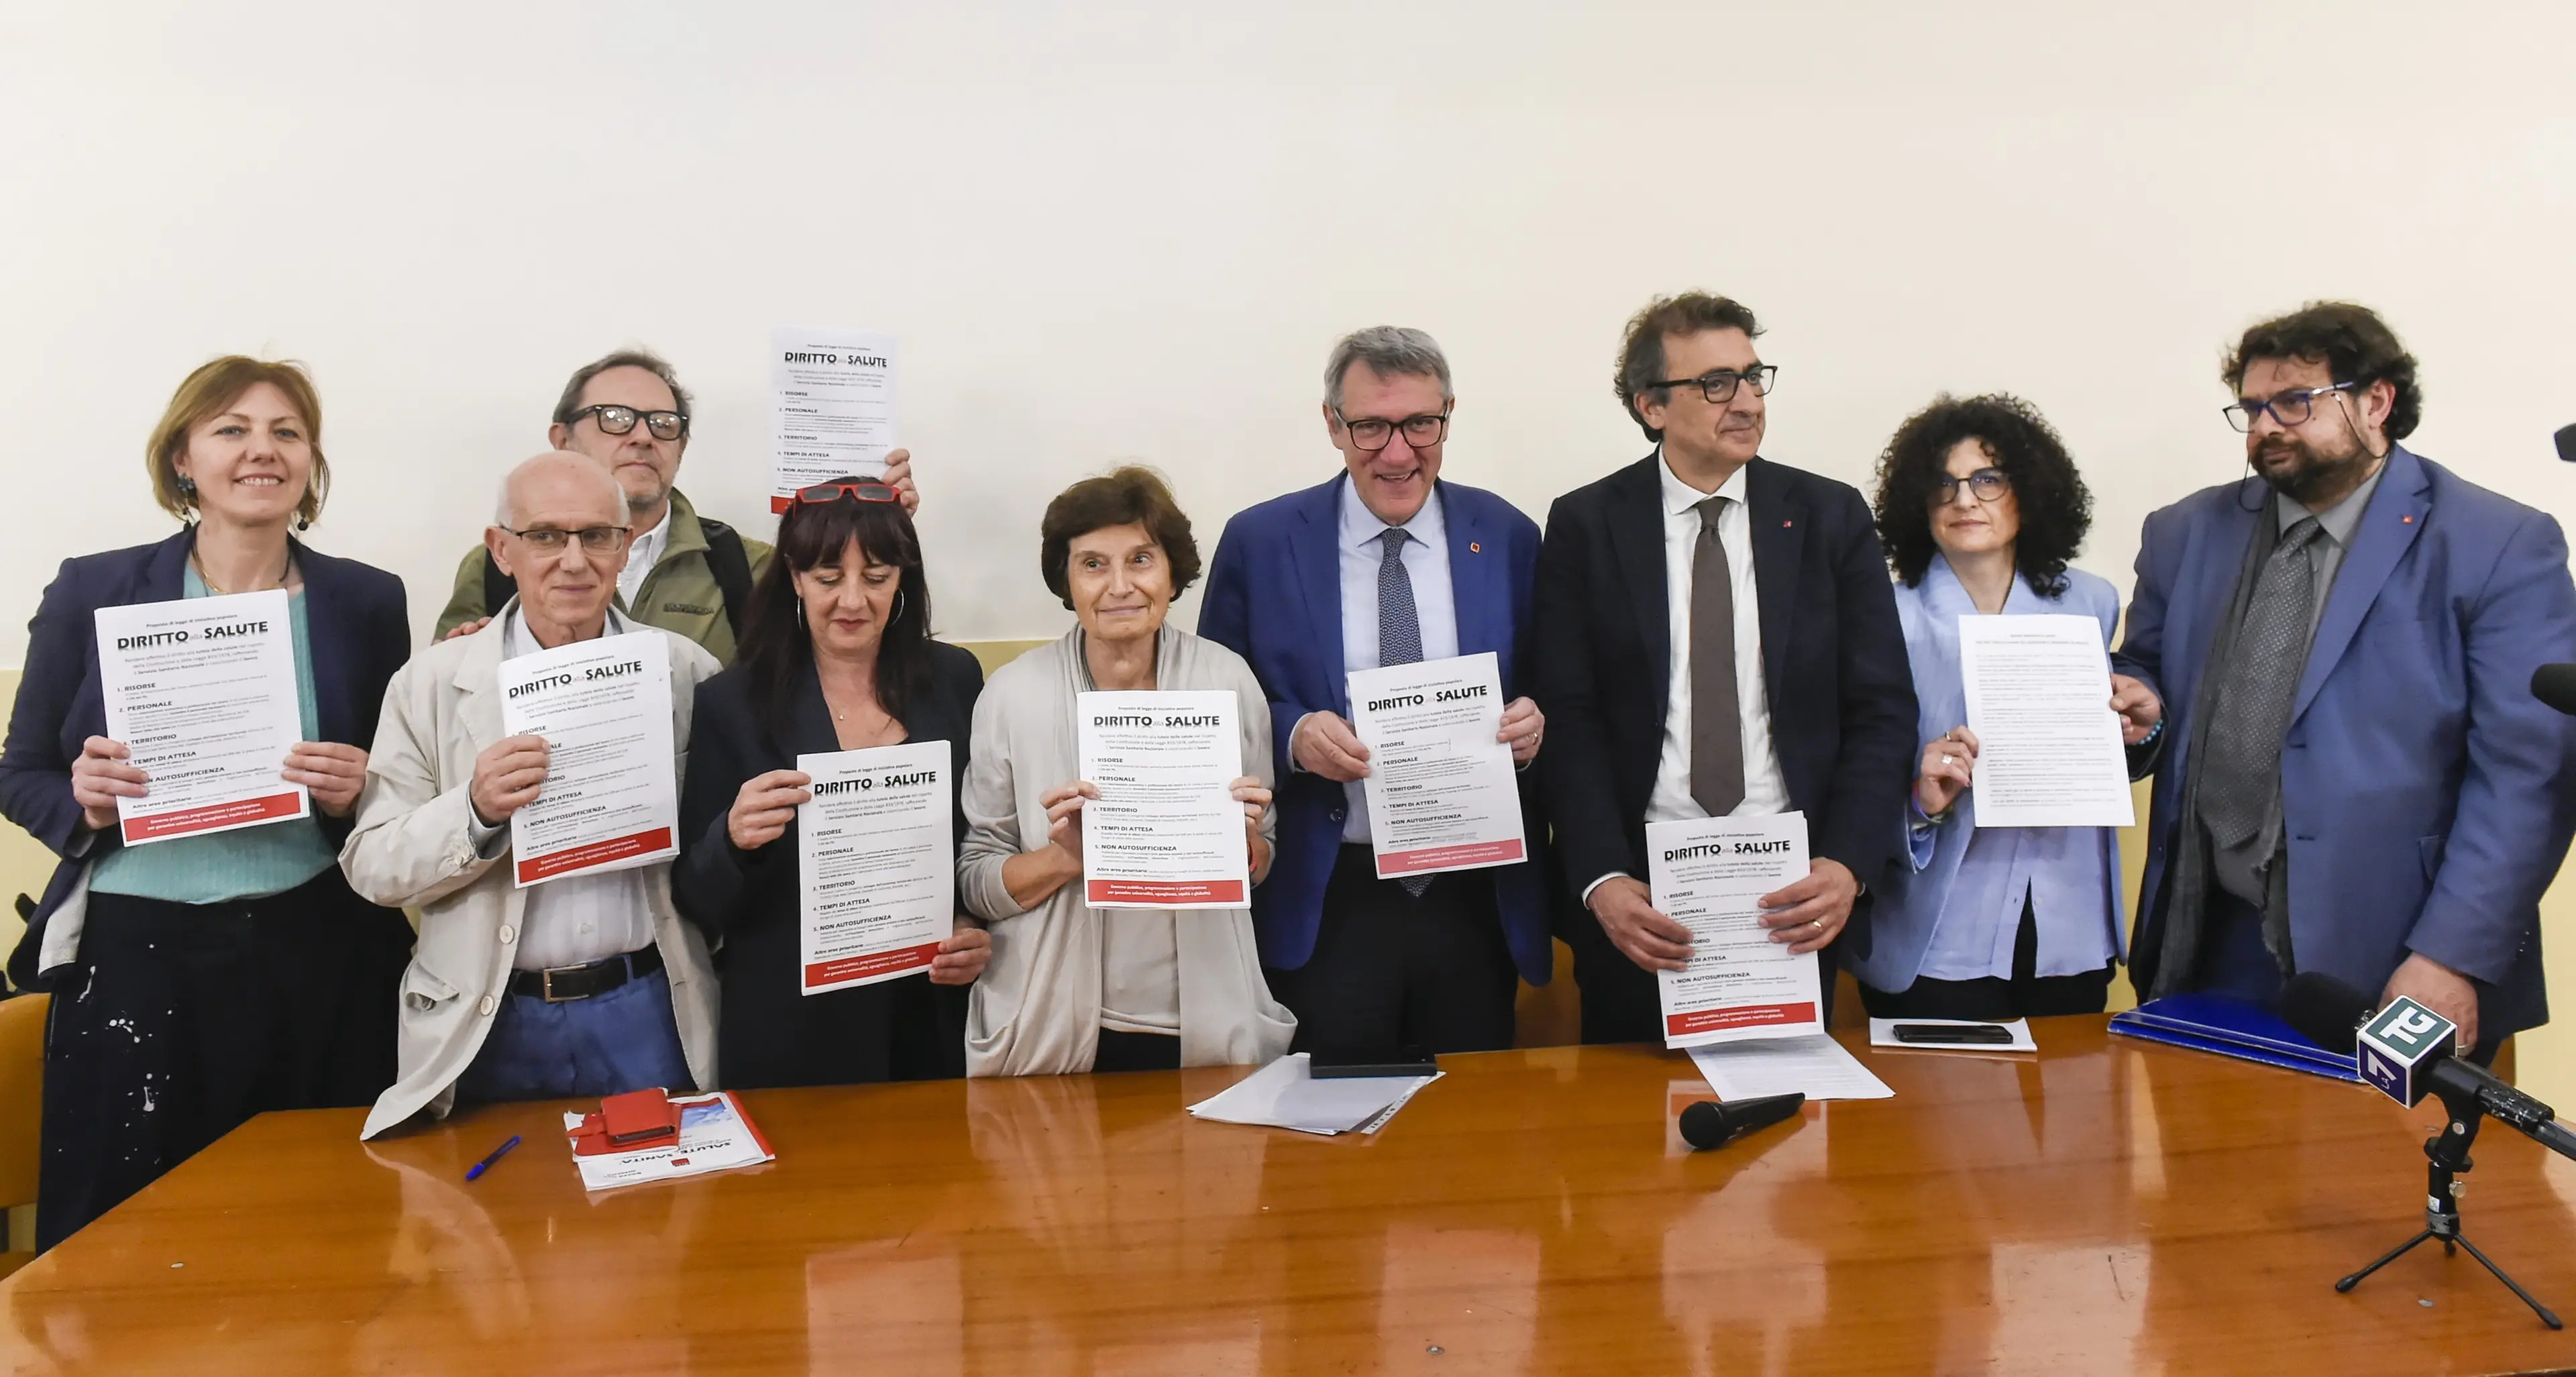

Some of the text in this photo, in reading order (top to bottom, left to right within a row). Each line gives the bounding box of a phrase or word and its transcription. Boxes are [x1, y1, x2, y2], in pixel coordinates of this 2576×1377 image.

[785, 352, 837, 364] DIRITTO
[848, 355, 887, 368] SALUTE
[117, 630, 189, 649] DIRITTO
[205, 621, 268, 639] SALUTE
[508, 673, 572, 698] DIRITTO
[586, 661, 642, 680] SALUTE
[124, 683, 155, 691] RISORSE
[1368, 694, 1424, 711] DIRITTO
[1436, 685, 1487, 702] SALUTE
[127, 701, 172, 711] PERSONALE
[1094, 716, 1152, 726] DIRITTO
[1165, 716, 1220, 726] SALUTE
[131, 734, 176, 745] TERRITORIO
[167, 751, 196, 759] ATTESA
[1383, 757, 1417, 765] PERSONALE
[155, 767, 225, 781] AUTOSUFFICIENZA
[541, 775, 566, 783] ITORIO
[814, 778, 872, 795] DIRITTO
[884, 771, 936, 787] SALUTE
[1386, 784, 1422, 792] TERRITORIO
[527, 799, 547, 807] TEMPI
[557, 791, 582, 801] ATTESA
[546, 806, 606, 822] AUTOSUFFICIENZA
[1406, 814, 1462, 823] AUTOSUFFICIENZA
[817, 828, 841, 836] RISORSE
[818, 847, 853, 857] PERSONALE
[1664, 844, 1721, 861] DIRITTO
[1734, 840, 1790, 853] SALUTE
[819, 880, 855, 890] TERRITORIO
[847, 898, 869, 906] ATTESA
[1671, 907, 1706, 916] PERSONALE
[835, 915, 891, 928] AUTOSUFFICIENZA
[1693, 972, 1750, 981] AUTOSUFFICIENZA
[2379, 1006, 2438, 1045] TG
[680, 1142, 731, 1154] SALUTE
